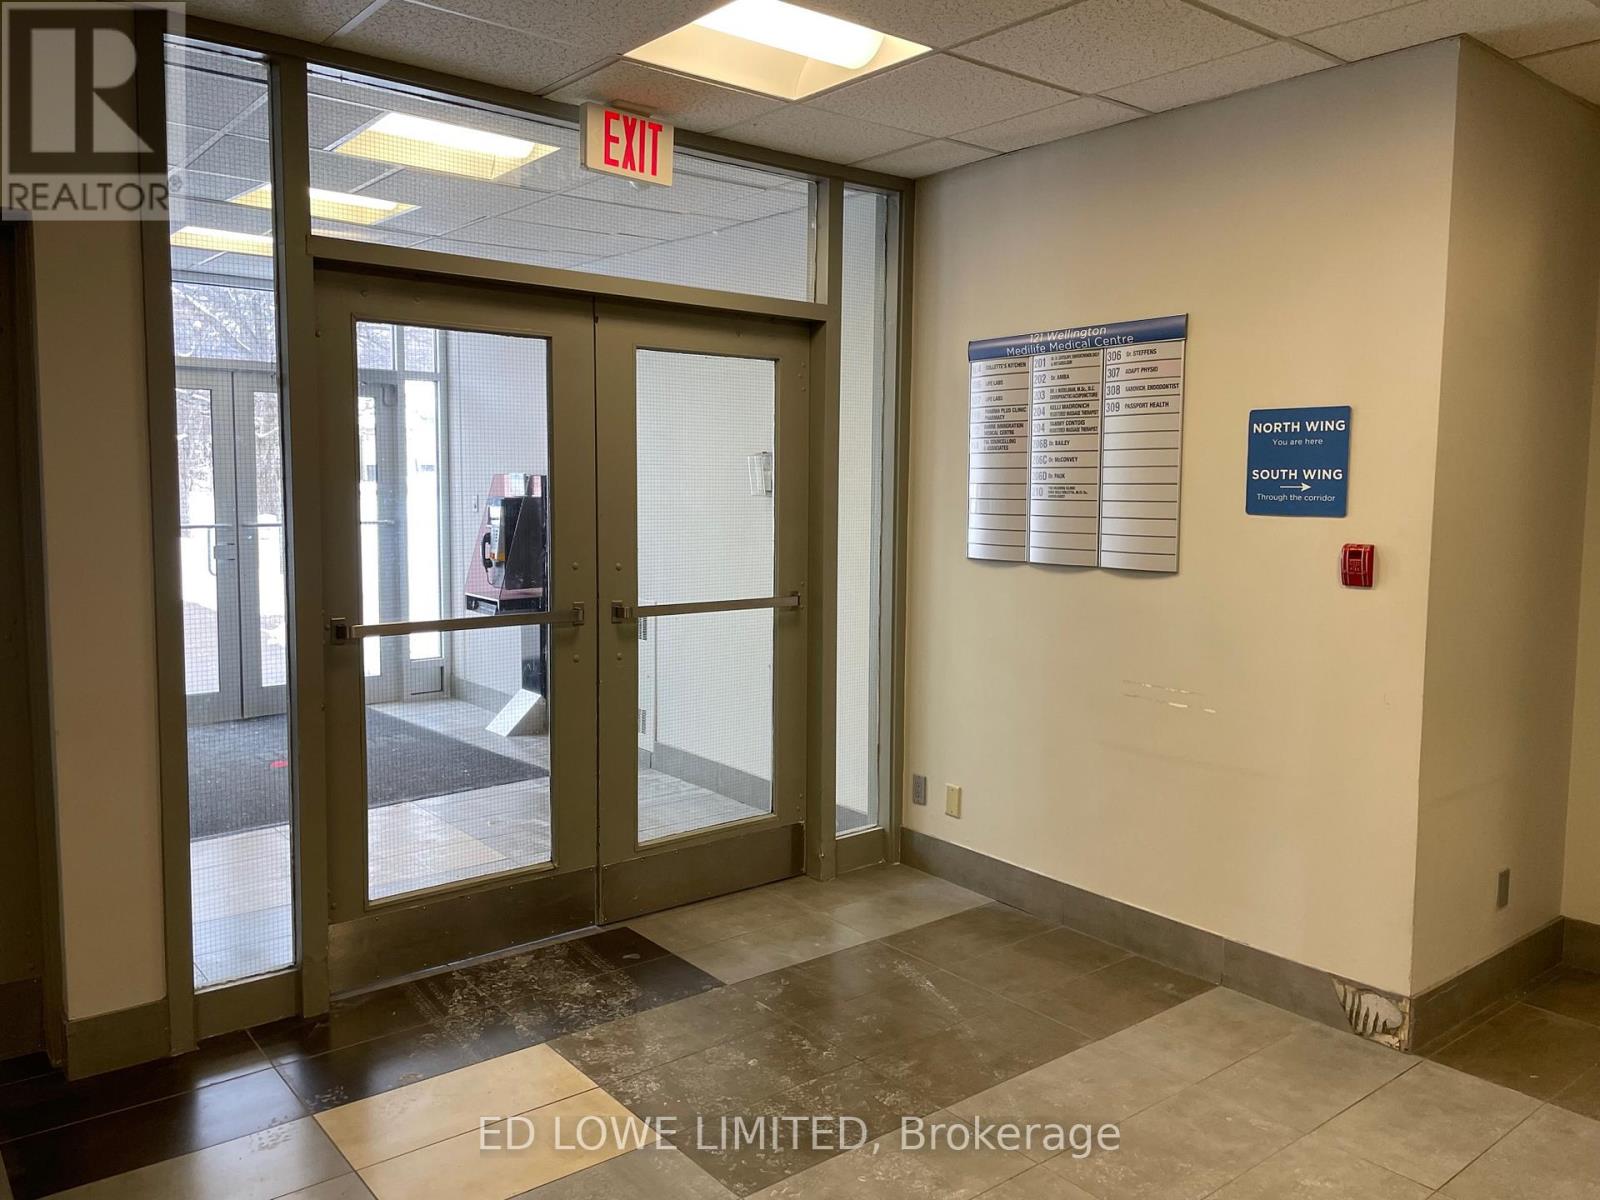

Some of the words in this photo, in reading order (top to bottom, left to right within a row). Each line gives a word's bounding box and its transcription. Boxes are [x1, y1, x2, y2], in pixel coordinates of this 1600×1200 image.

[604, 110, 663, 176] EXIT
[1030, 334, 1044, 343] 121
[1047, 327, 1107, 341] Wellington
[1006, 344, 1046, 356] Medilife
[1050, 339, 1091, 352] Medical
[1094, 335, 1134, 347] Centre
[1107, 350, 1121, 361] 306
[1034, 358, 1046, 368] 201
[1107, 368, 1120, 378] 307
[1034, 374, 1046, 384] 202
[1106, 385, 1121, 395] 308
[1034, 406, 1046, 417] 204
[1106, 402, 1120, 412] 309
[1253, 422, 1300, 434] NORTH
[1305, 420, 1346, 432] WING
[1272, 438, 1288, 446] You
[1252, 469, 1298, 480] SOUTH
[1303, 469, 1343, 480] WING
[1256, 493, 1288, 502] Through
[1289, 493, 1302, 501] the
[1303, 494, 1336, 502] corridor
